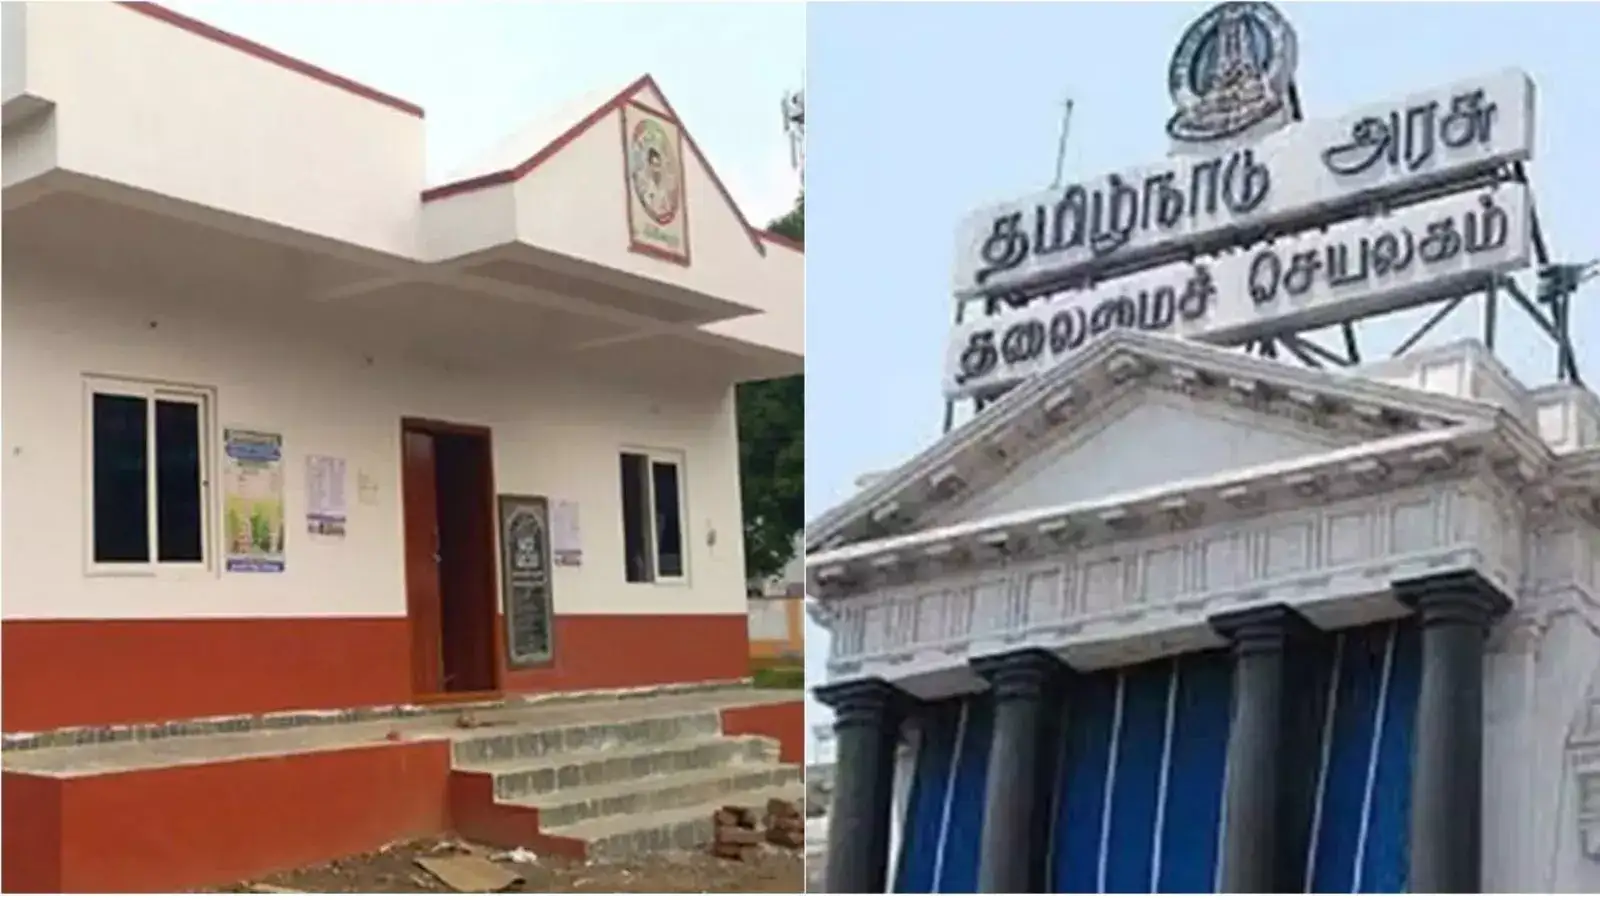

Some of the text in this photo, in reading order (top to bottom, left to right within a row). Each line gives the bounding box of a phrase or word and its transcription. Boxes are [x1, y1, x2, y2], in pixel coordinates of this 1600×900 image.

[976, 89, 1498, 284] தமிழ்நாடு அரசு
[956, 194, 1508, 384] தலைமைச் செயலகம்
